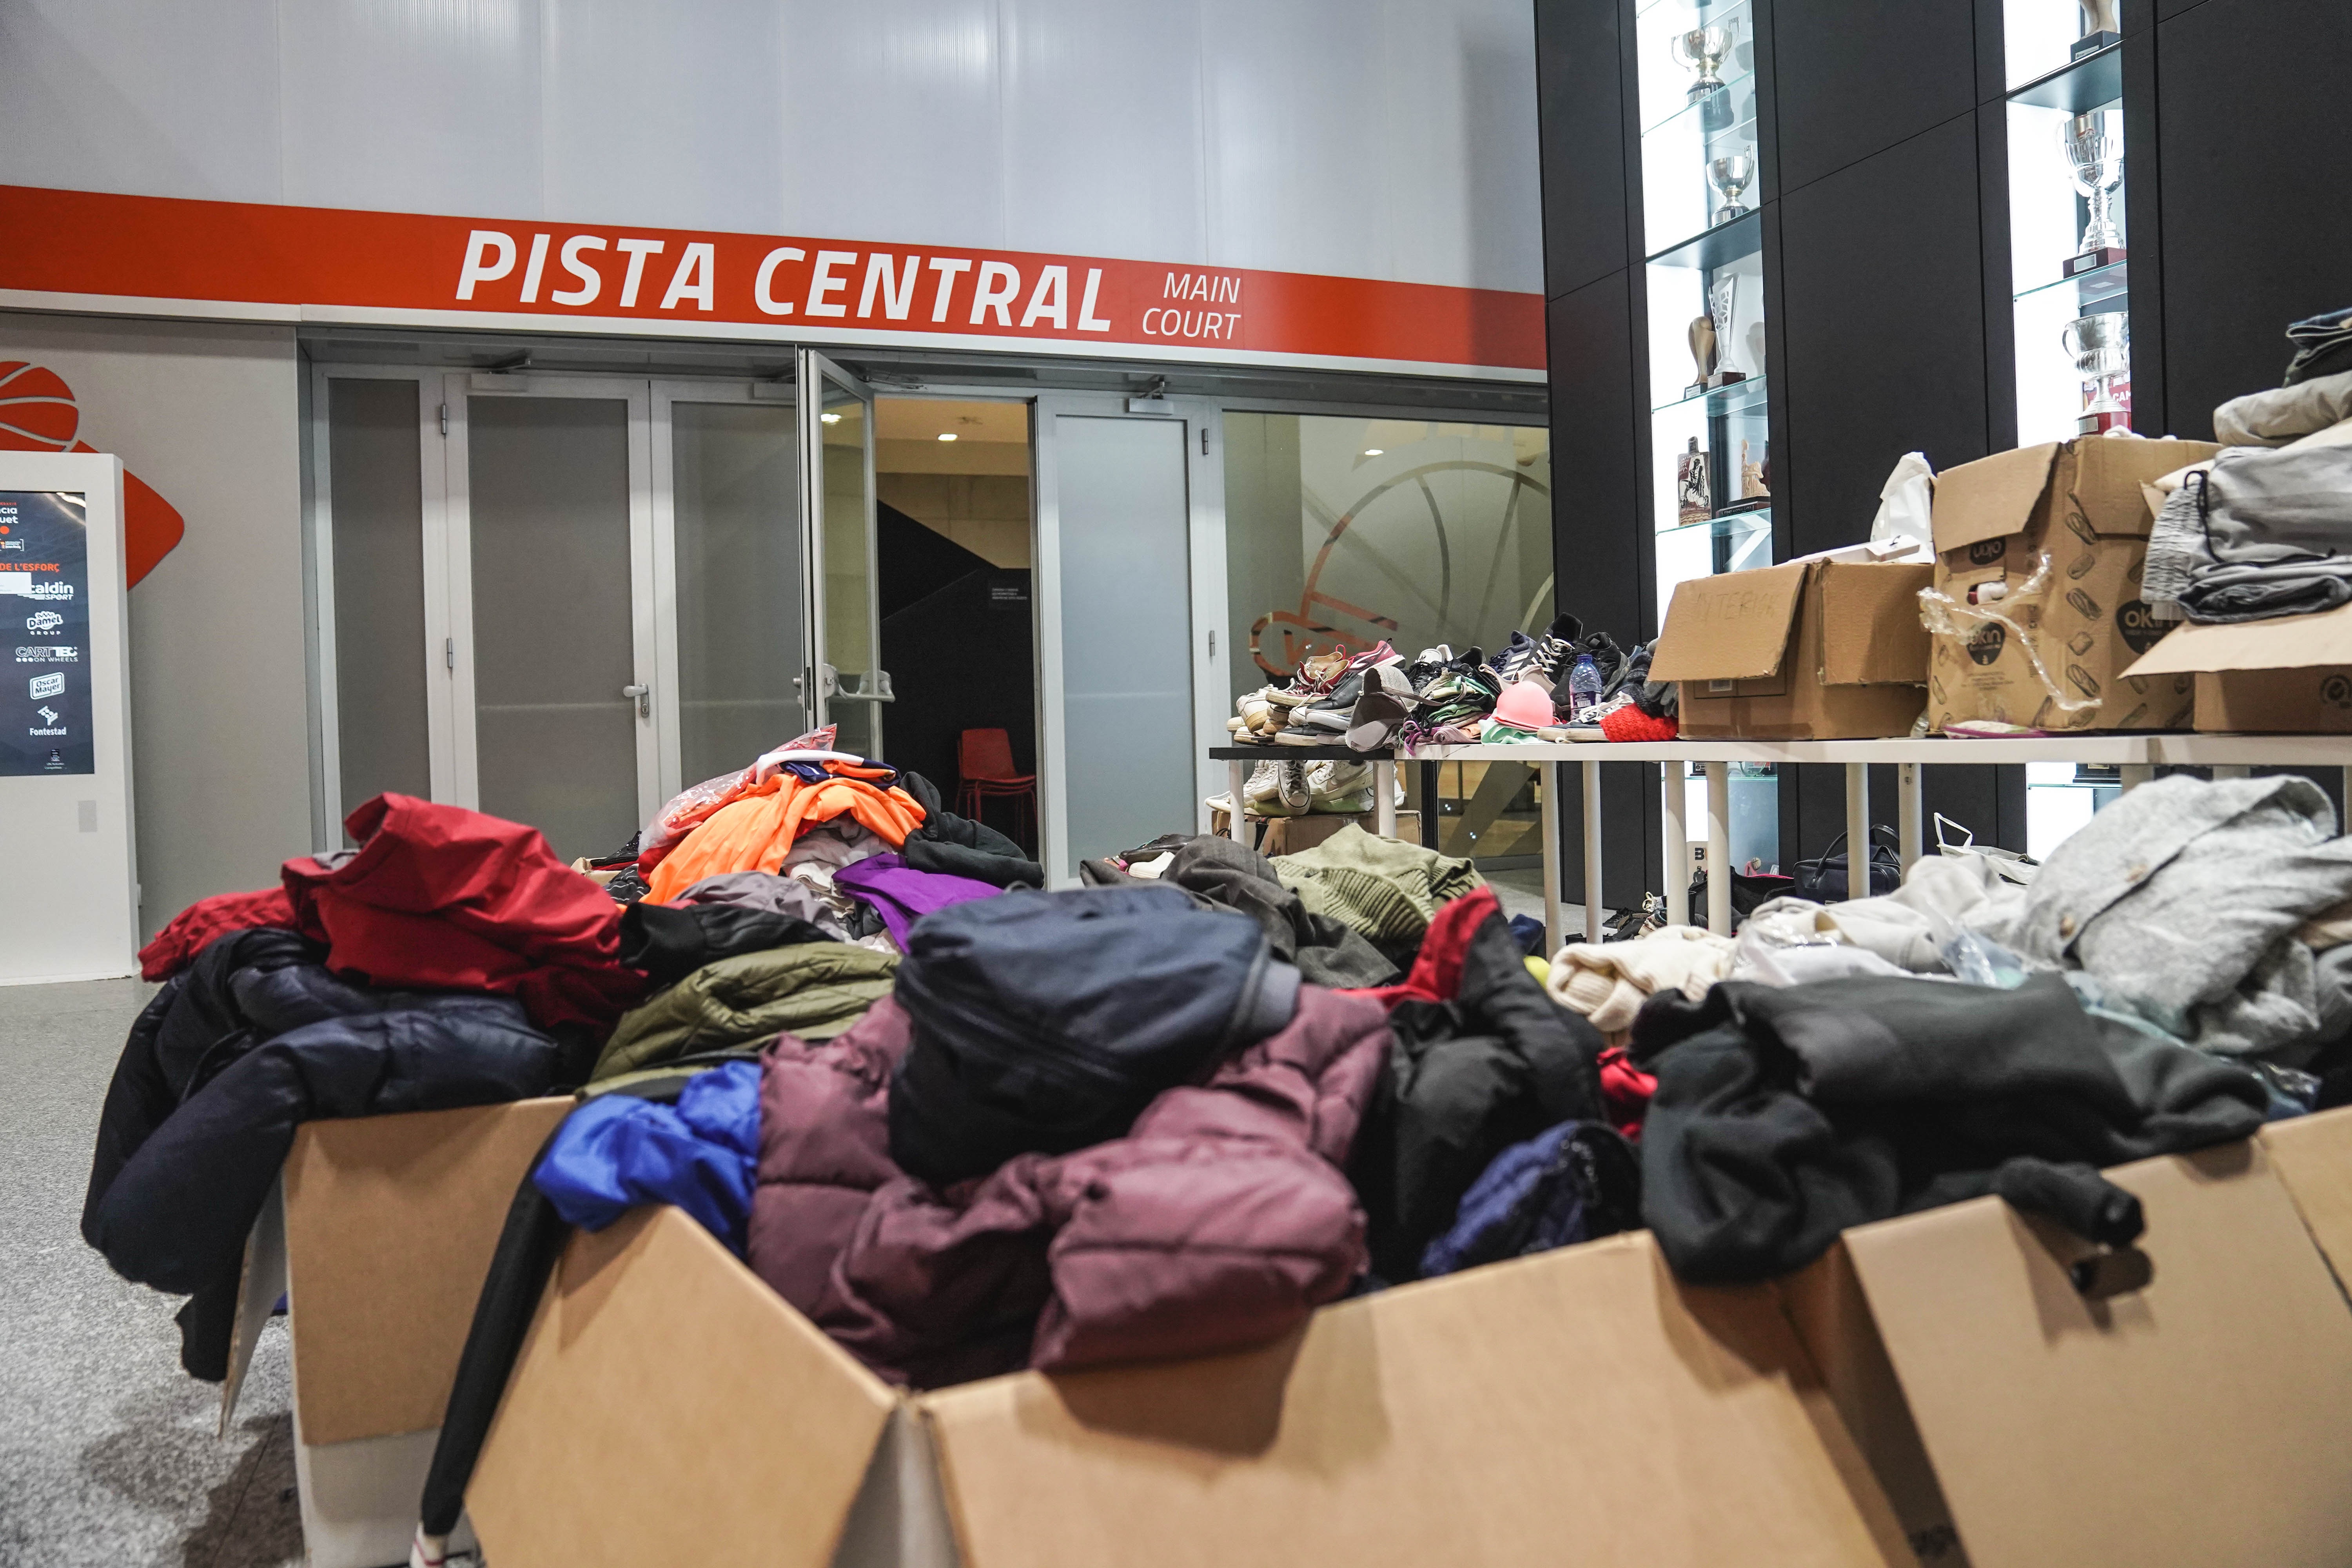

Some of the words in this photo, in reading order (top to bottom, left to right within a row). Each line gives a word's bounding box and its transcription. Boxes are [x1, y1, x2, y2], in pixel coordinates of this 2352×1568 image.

[456, 230, 715, 311] PISTA
[754, 247, 1111, 332] CENTRAL
[1163, 272, 1241, 304] MAIN
[1142, 308, 1241, 340] COURT
[15, 563, 60, 573] L'ESFORÇ
[30, 616, 60, 627] Damel
[36, 678, 58, 687] Oscar
[35, 684, 60, 694] Mayer
[29, 727, 67, 736] Fontestad
